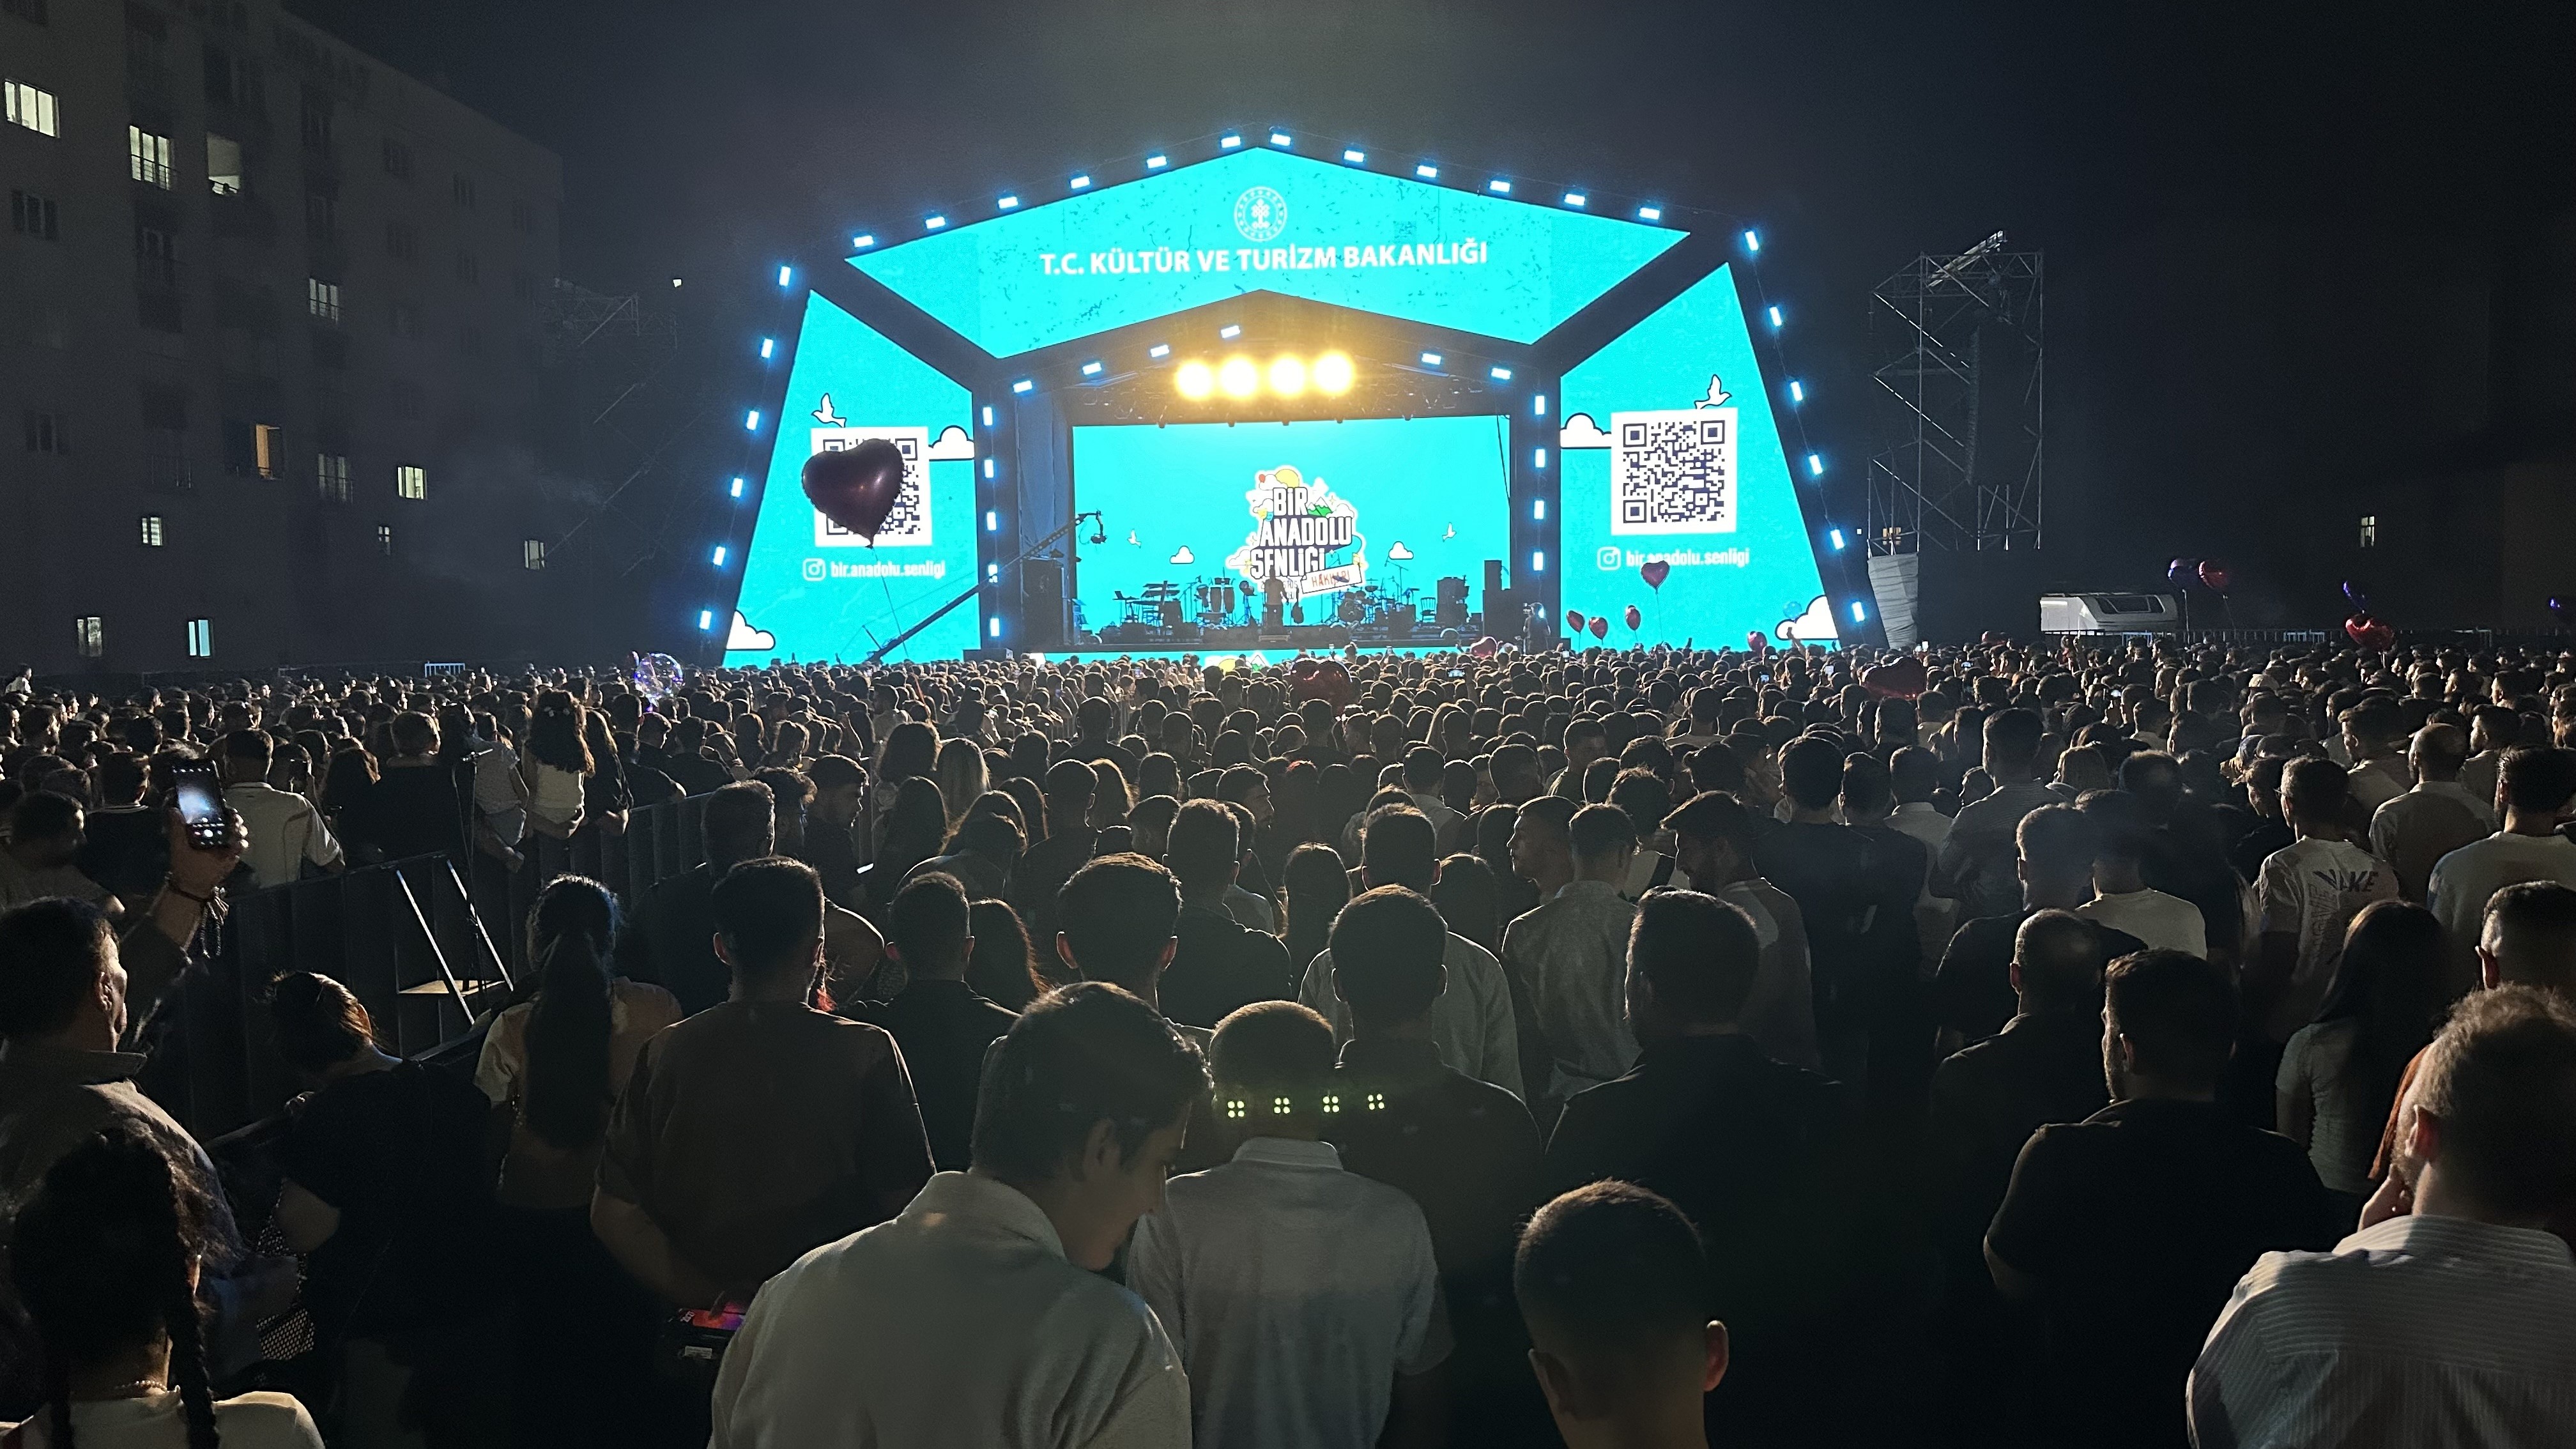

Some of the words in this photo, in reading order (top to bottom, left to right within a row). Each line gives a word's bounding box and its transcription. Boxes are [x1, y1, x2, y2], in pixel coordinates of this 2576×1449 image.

[1039, 252, 1084, 275] T.C.
[1091, 246, 1191, 274] KÜLTÜR
[1197, 250, 1230, 272] VE
[1236, 243, 1337, 271] TURİZM
[1344, 237, 1487, 268] BAKANLIĞI
[1260, 517, 1352, 546] ANADOLU
[831, 560, 946, 579] bir.anadolu.senligi
